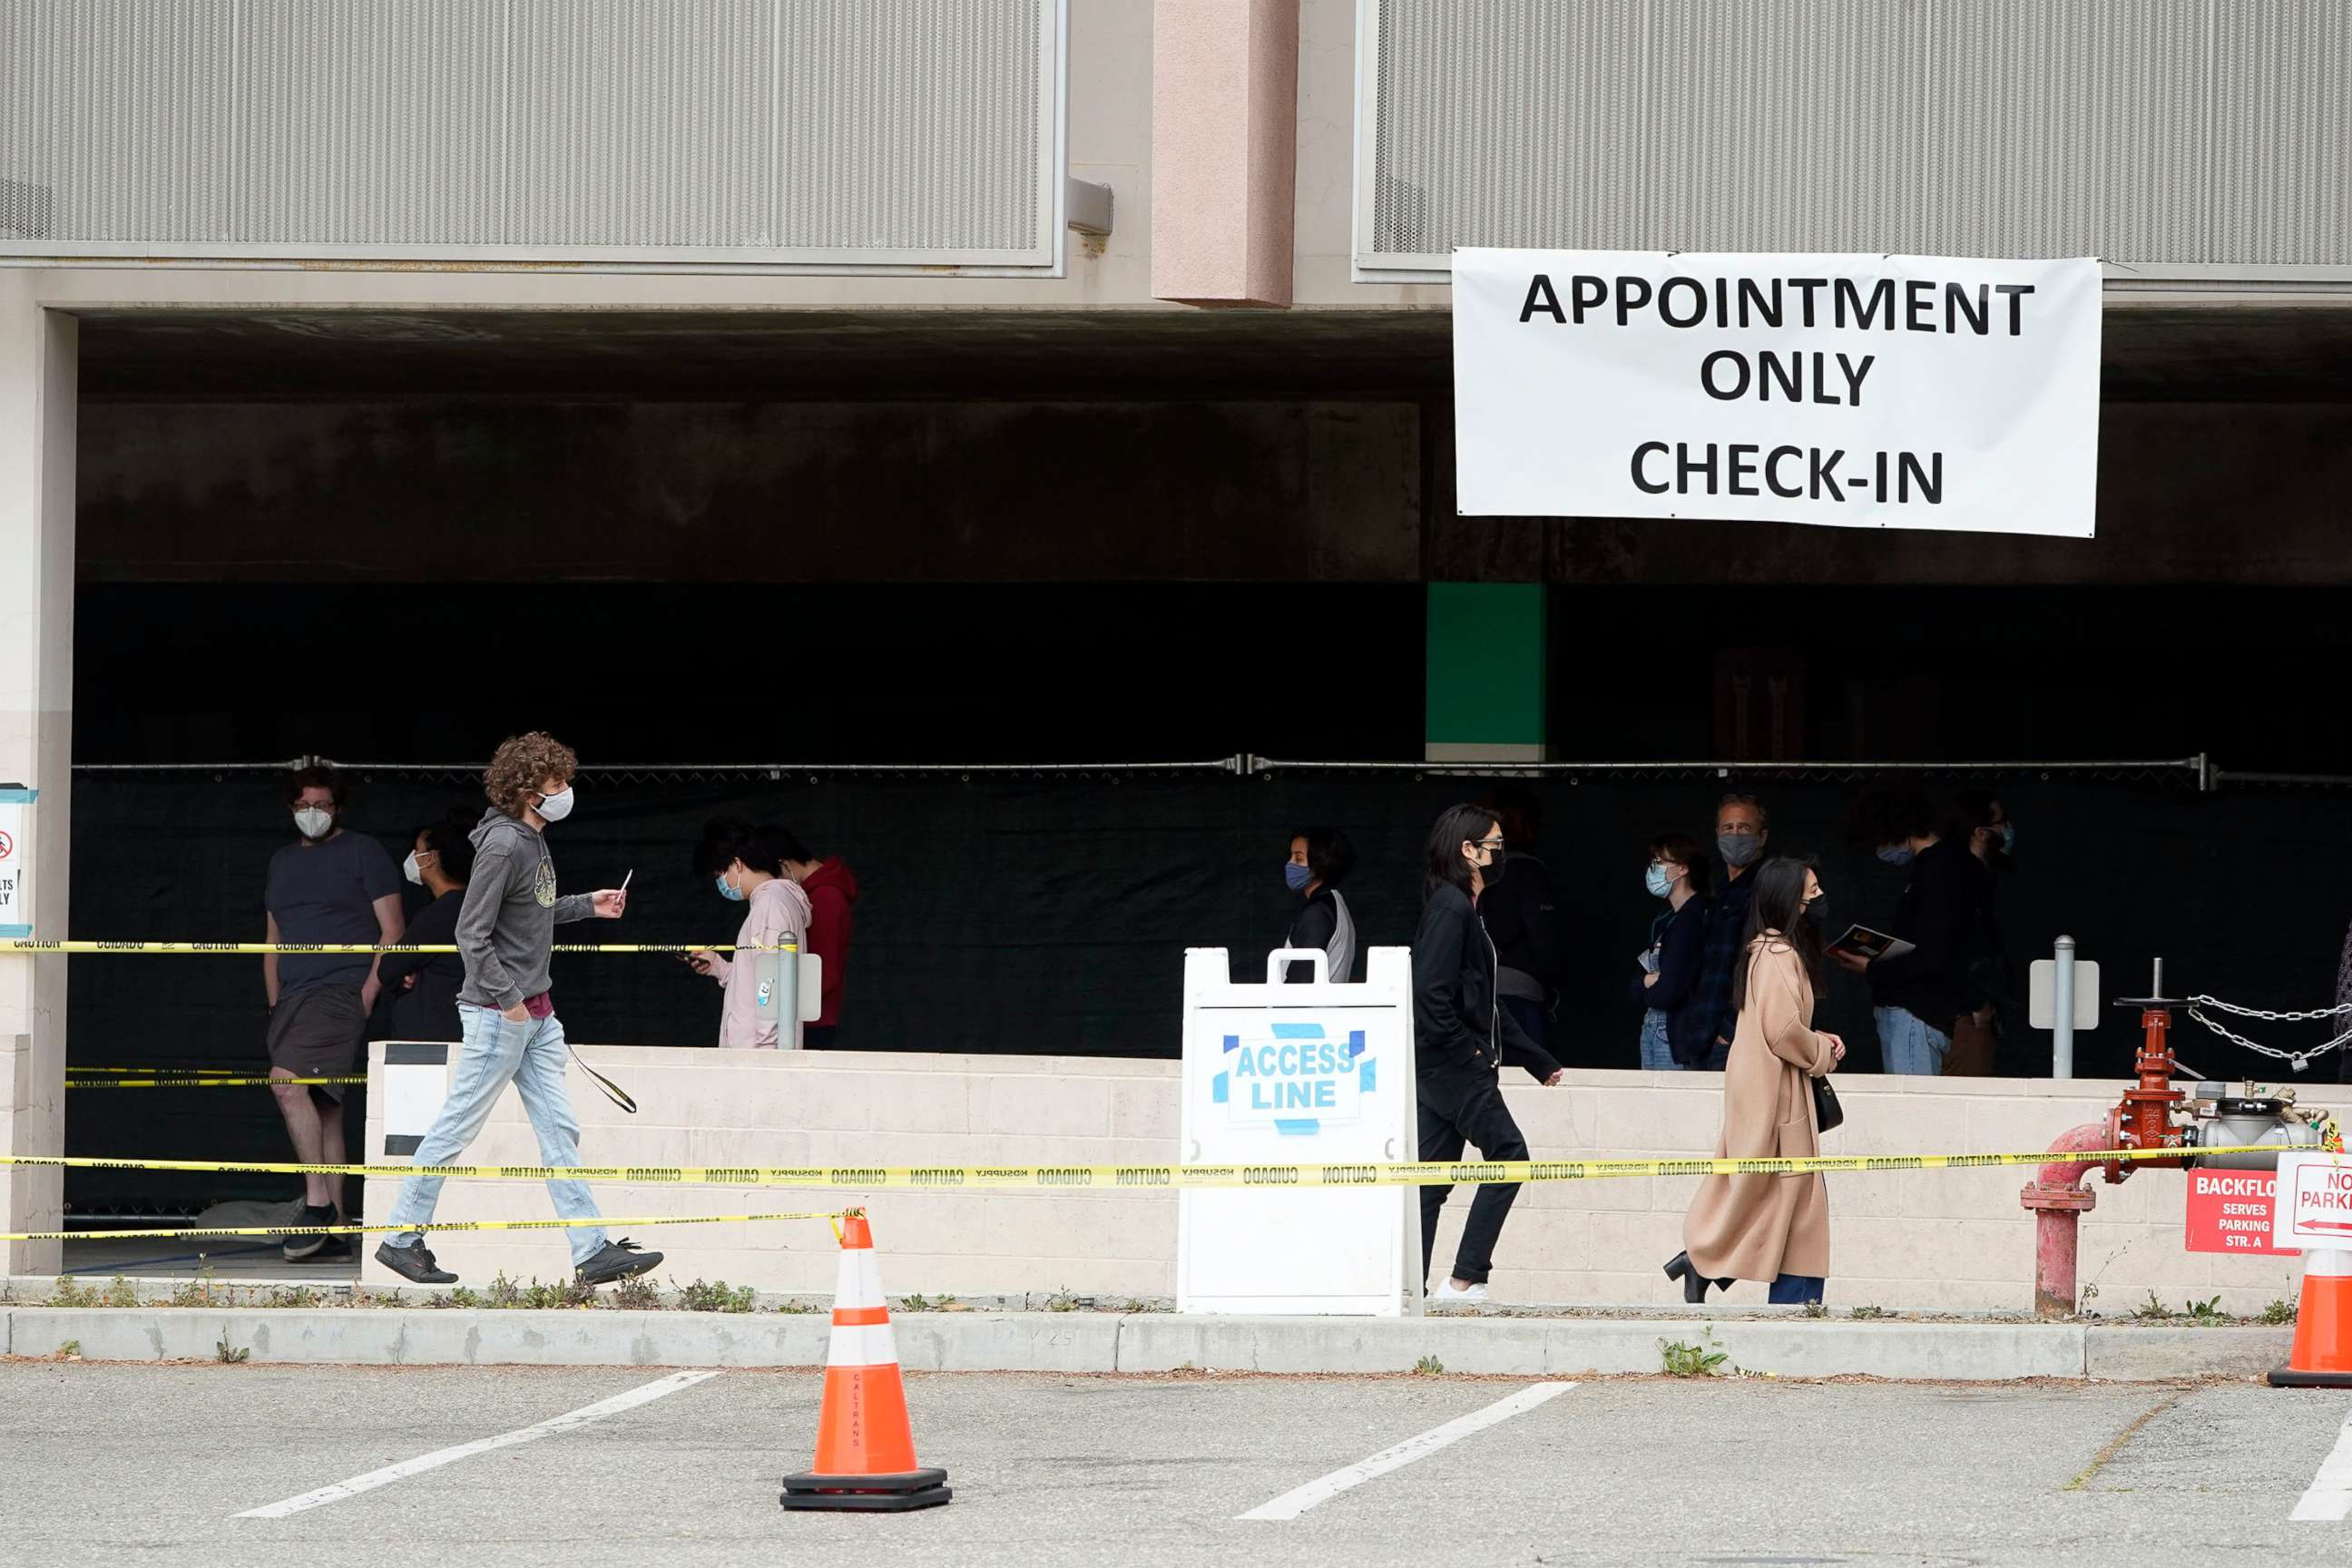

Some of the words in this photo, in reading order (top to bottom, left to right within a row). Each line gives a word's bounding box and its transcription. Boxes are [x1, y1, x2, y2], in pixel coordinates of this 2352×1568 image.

[1519, 273, 2035, 337] APPOINTMENT
[1700, 349, 1876, 407] ONLY
[1630, 440, 1944, 505] CHECK-IN
[1235, 1043, 1355, 1077] ACCESS
[1251, 1080, 1337, 1110] LINE
[2328, 1173, 2352, 1190] NO
[2223, 1203, 2267, 1216] SERVES
[2219, 1219, 2270, 1232] PARKING
[2226, 1235, 2251, 1248] STR.
[2253, 1237, 2262, 1248] A
